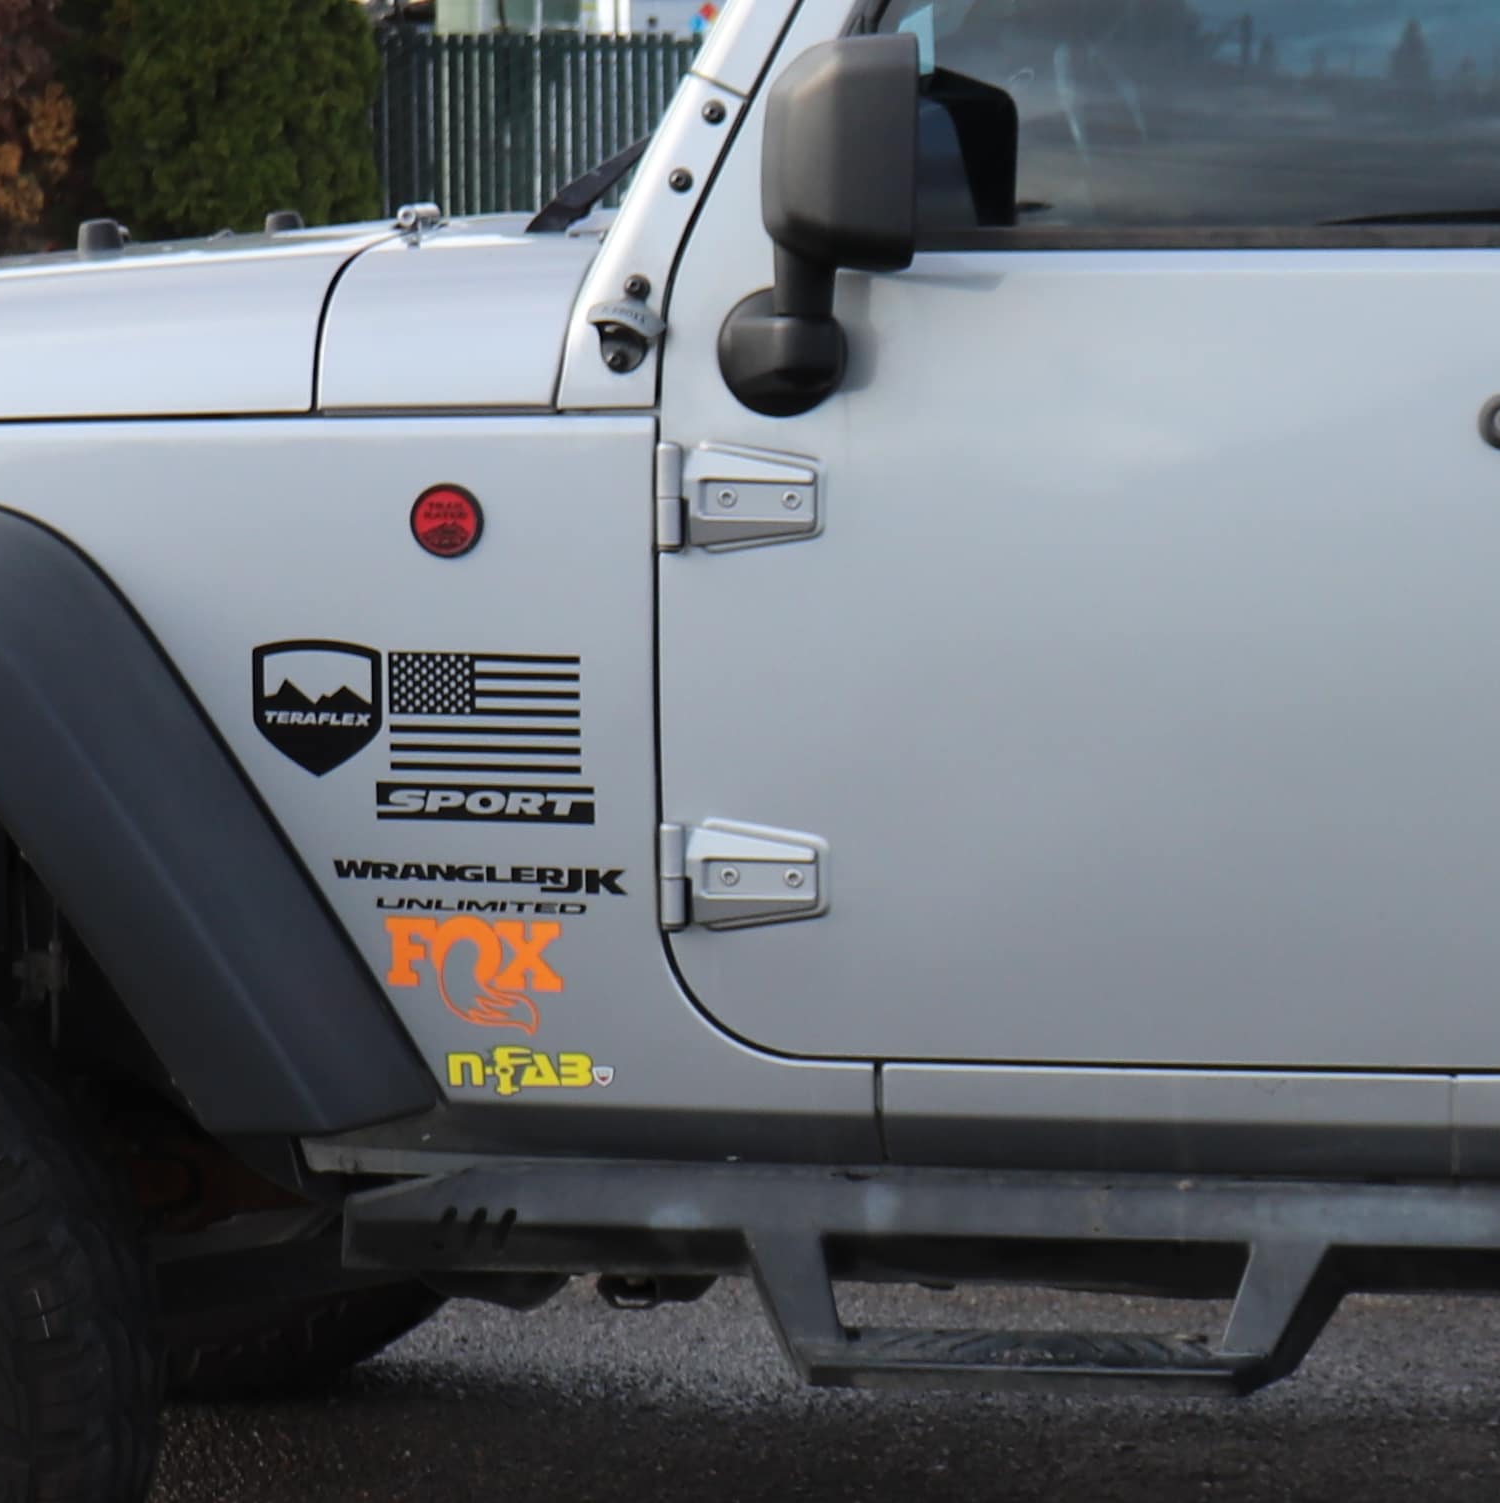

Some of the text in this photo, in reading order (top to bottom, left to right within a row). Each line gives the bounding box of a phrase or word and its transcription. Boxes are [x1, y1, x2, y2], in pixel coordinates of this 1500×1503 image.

[264, 709, 372, 727] TERAFLEX
[387, 788, 579, 818] SPORT
[375, 897, 587, 915] UNLIMITED
[385, 915, 564, 1035] FOX
